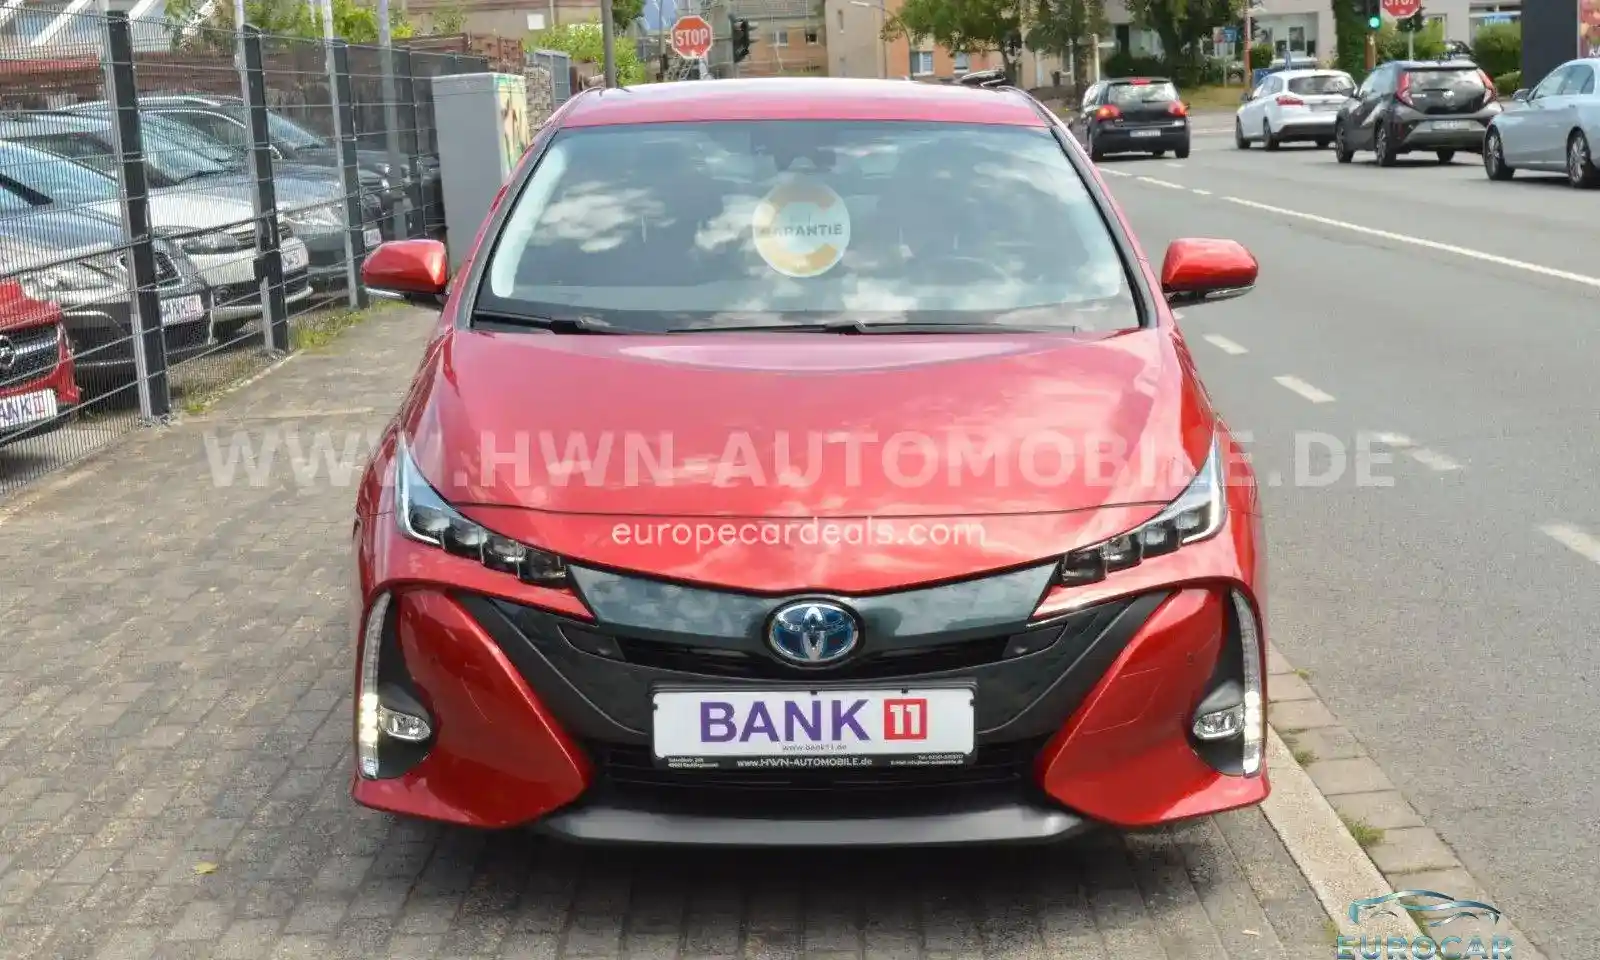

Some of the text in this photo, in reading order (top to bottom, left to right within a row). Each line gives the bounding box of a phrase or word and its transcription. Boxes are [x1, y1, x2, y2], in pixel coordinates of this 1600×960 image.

[675, 28, 708, 46] STOP
[700, 700, 922, 742] BANK 11
[737, 757, 873, 768] www.HWN-AUTOMOBILE.de
